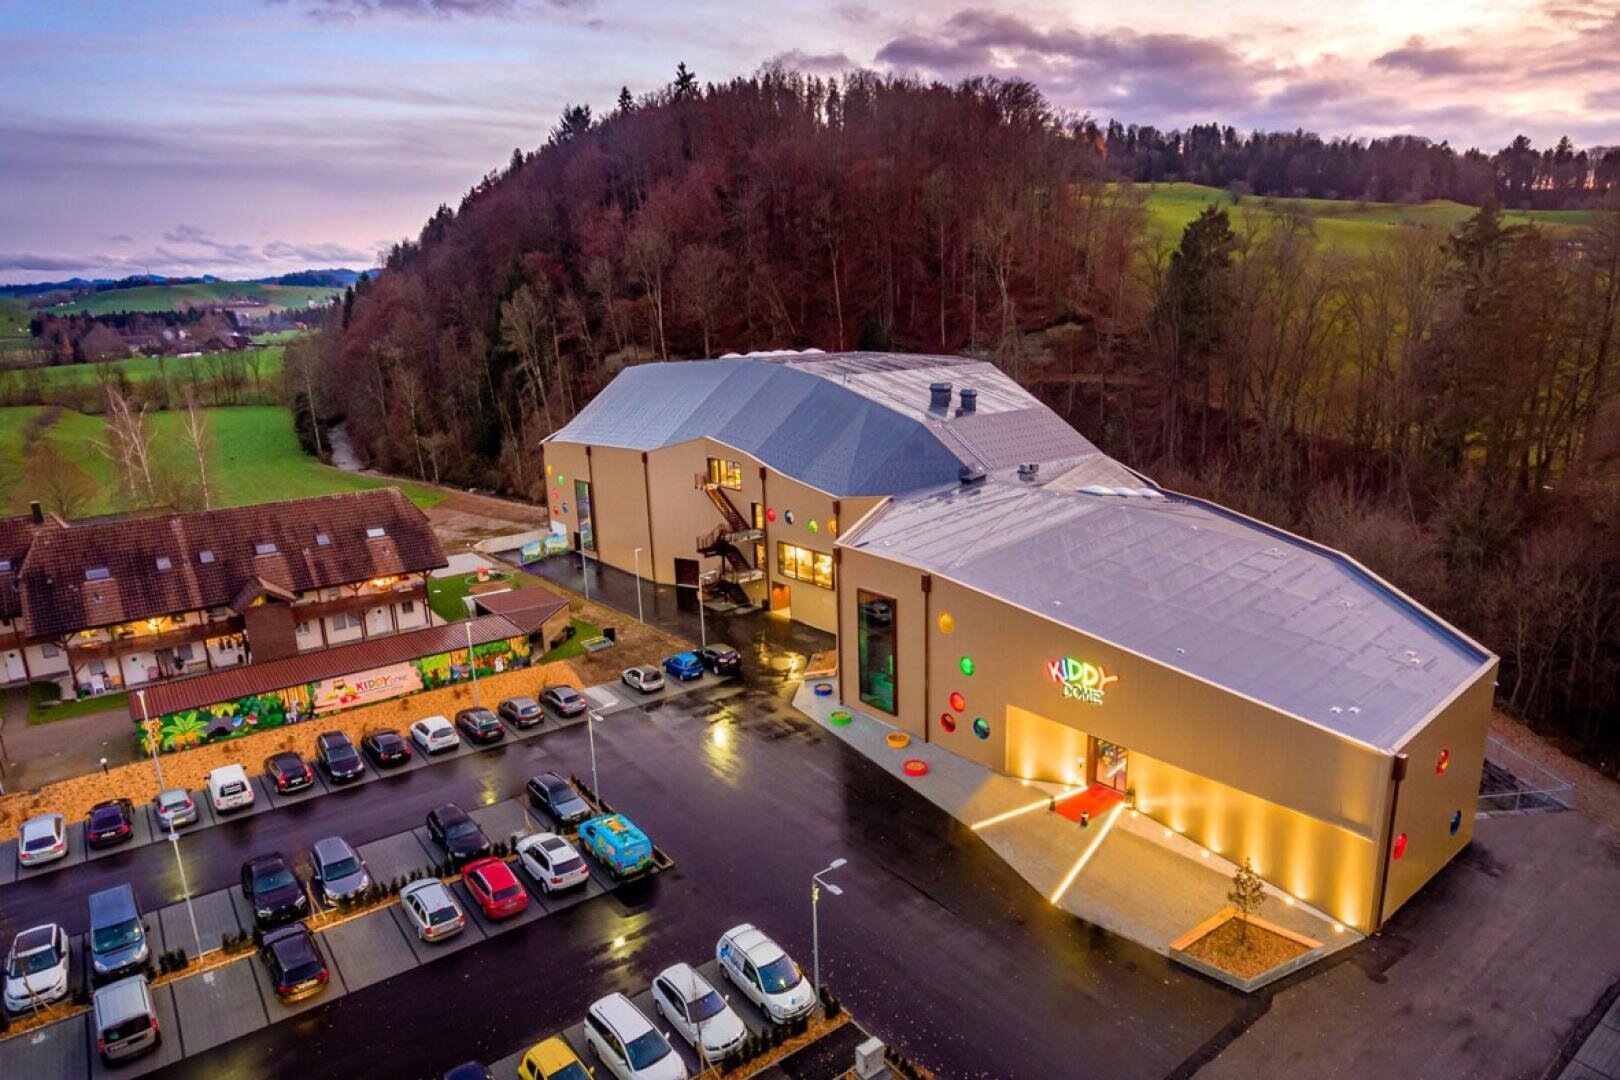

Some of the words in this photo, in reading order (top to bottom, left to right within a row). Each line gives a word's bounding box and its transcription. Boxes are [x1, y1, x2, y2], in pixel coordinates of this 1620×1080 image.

[355, 674, 391, 691] KIDDY
[1046, 657, 1119, 691] KIDDY
[1063, 683, 1105, 704] DOME
